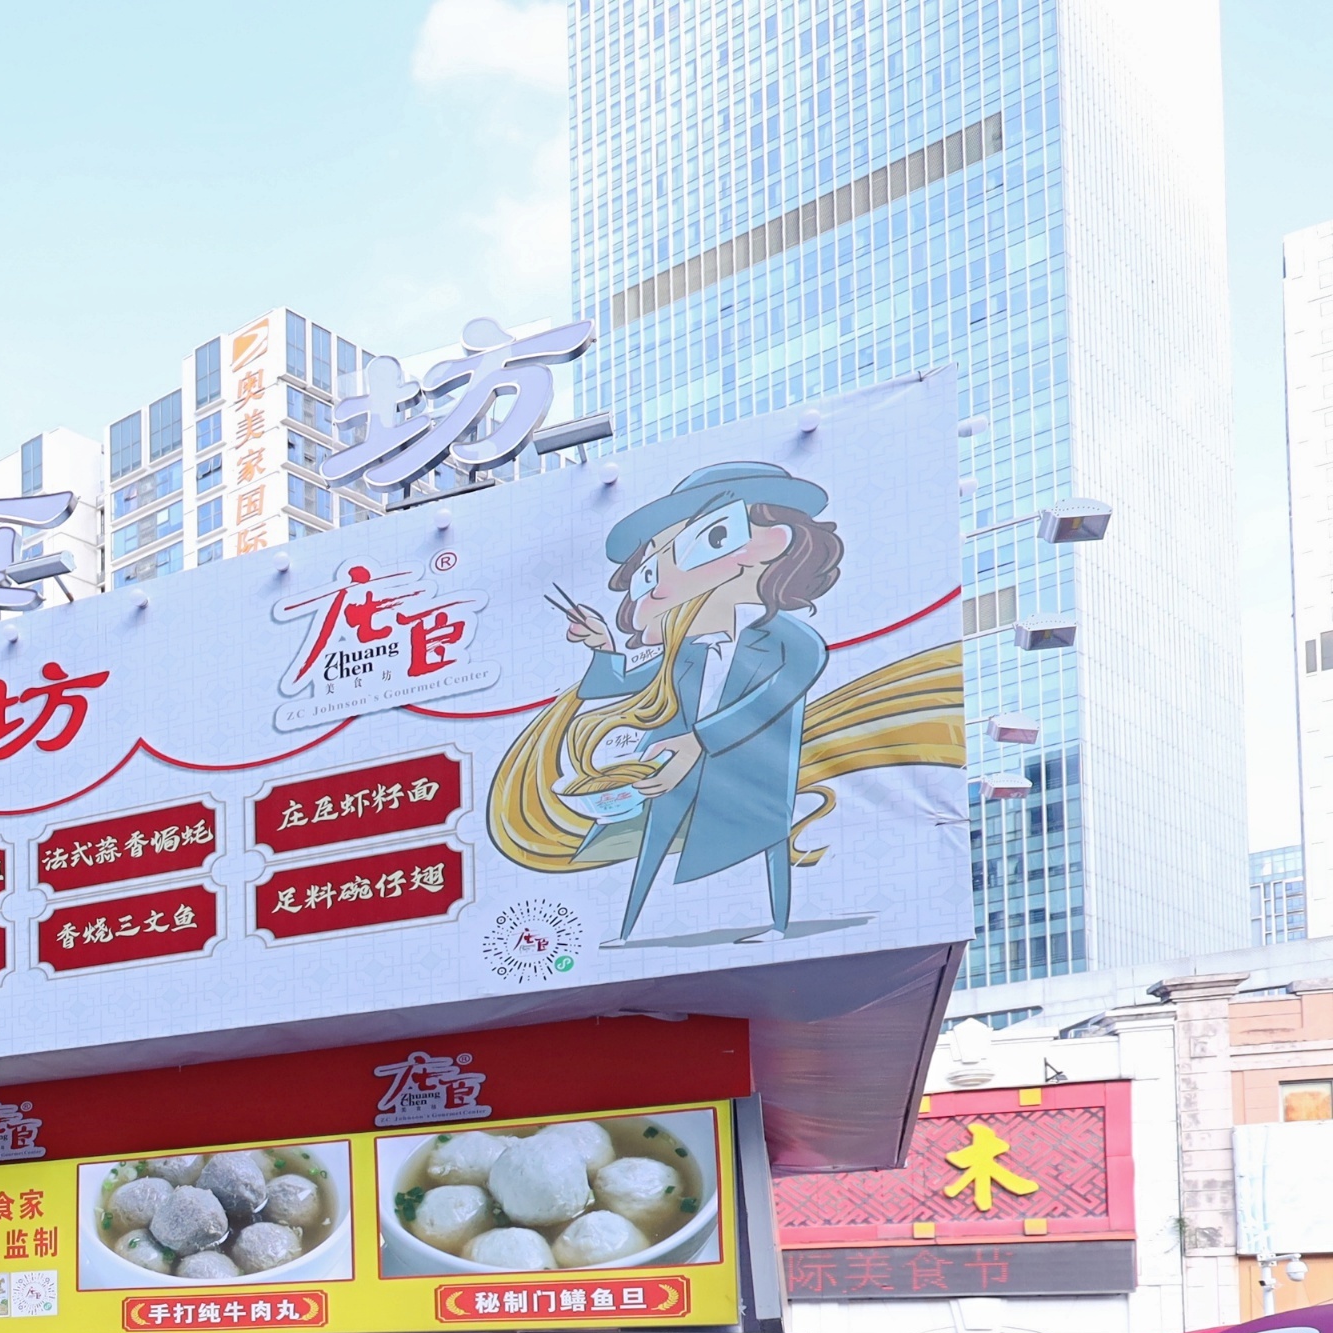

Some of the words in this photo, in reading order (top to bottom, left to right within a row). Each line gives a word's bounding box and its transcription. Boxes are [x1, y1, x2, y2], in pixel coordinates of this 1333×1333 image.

[234, 369, 268, 556] 奥美家国际
[284, 565, 477, 685] 庄臣
[323, 655, 374, 682] Chen
[324, 641, 399, 669] Zhuang
[287, 707, 306, 722] ZC
[383, 680, 441, 701] Gourmet
[443, 668, 490, 688] Center
[326, 669, 392, 695] 美食坊
[276, 776, 440, 832] 庄臣虾籽面
[41, 818, 215, 872] 法式蒜香焗蚝
[271, 861, 446, 916] 足料碗仔翅
[55, 903, 200, 951] 香烧三文鱼
[400, 1098, 428, 1107] Chen
[401, 1091, 440, 1101] Zhuang
[943, 1122, 1039, 1212] 木
[787, 1248, 1014, 1294] 际美食节
[148, 1299, 301, 1325] 手打纯牛肉丸
[474, 1287, 648, 1314] 秘制门鳝鱼旦
